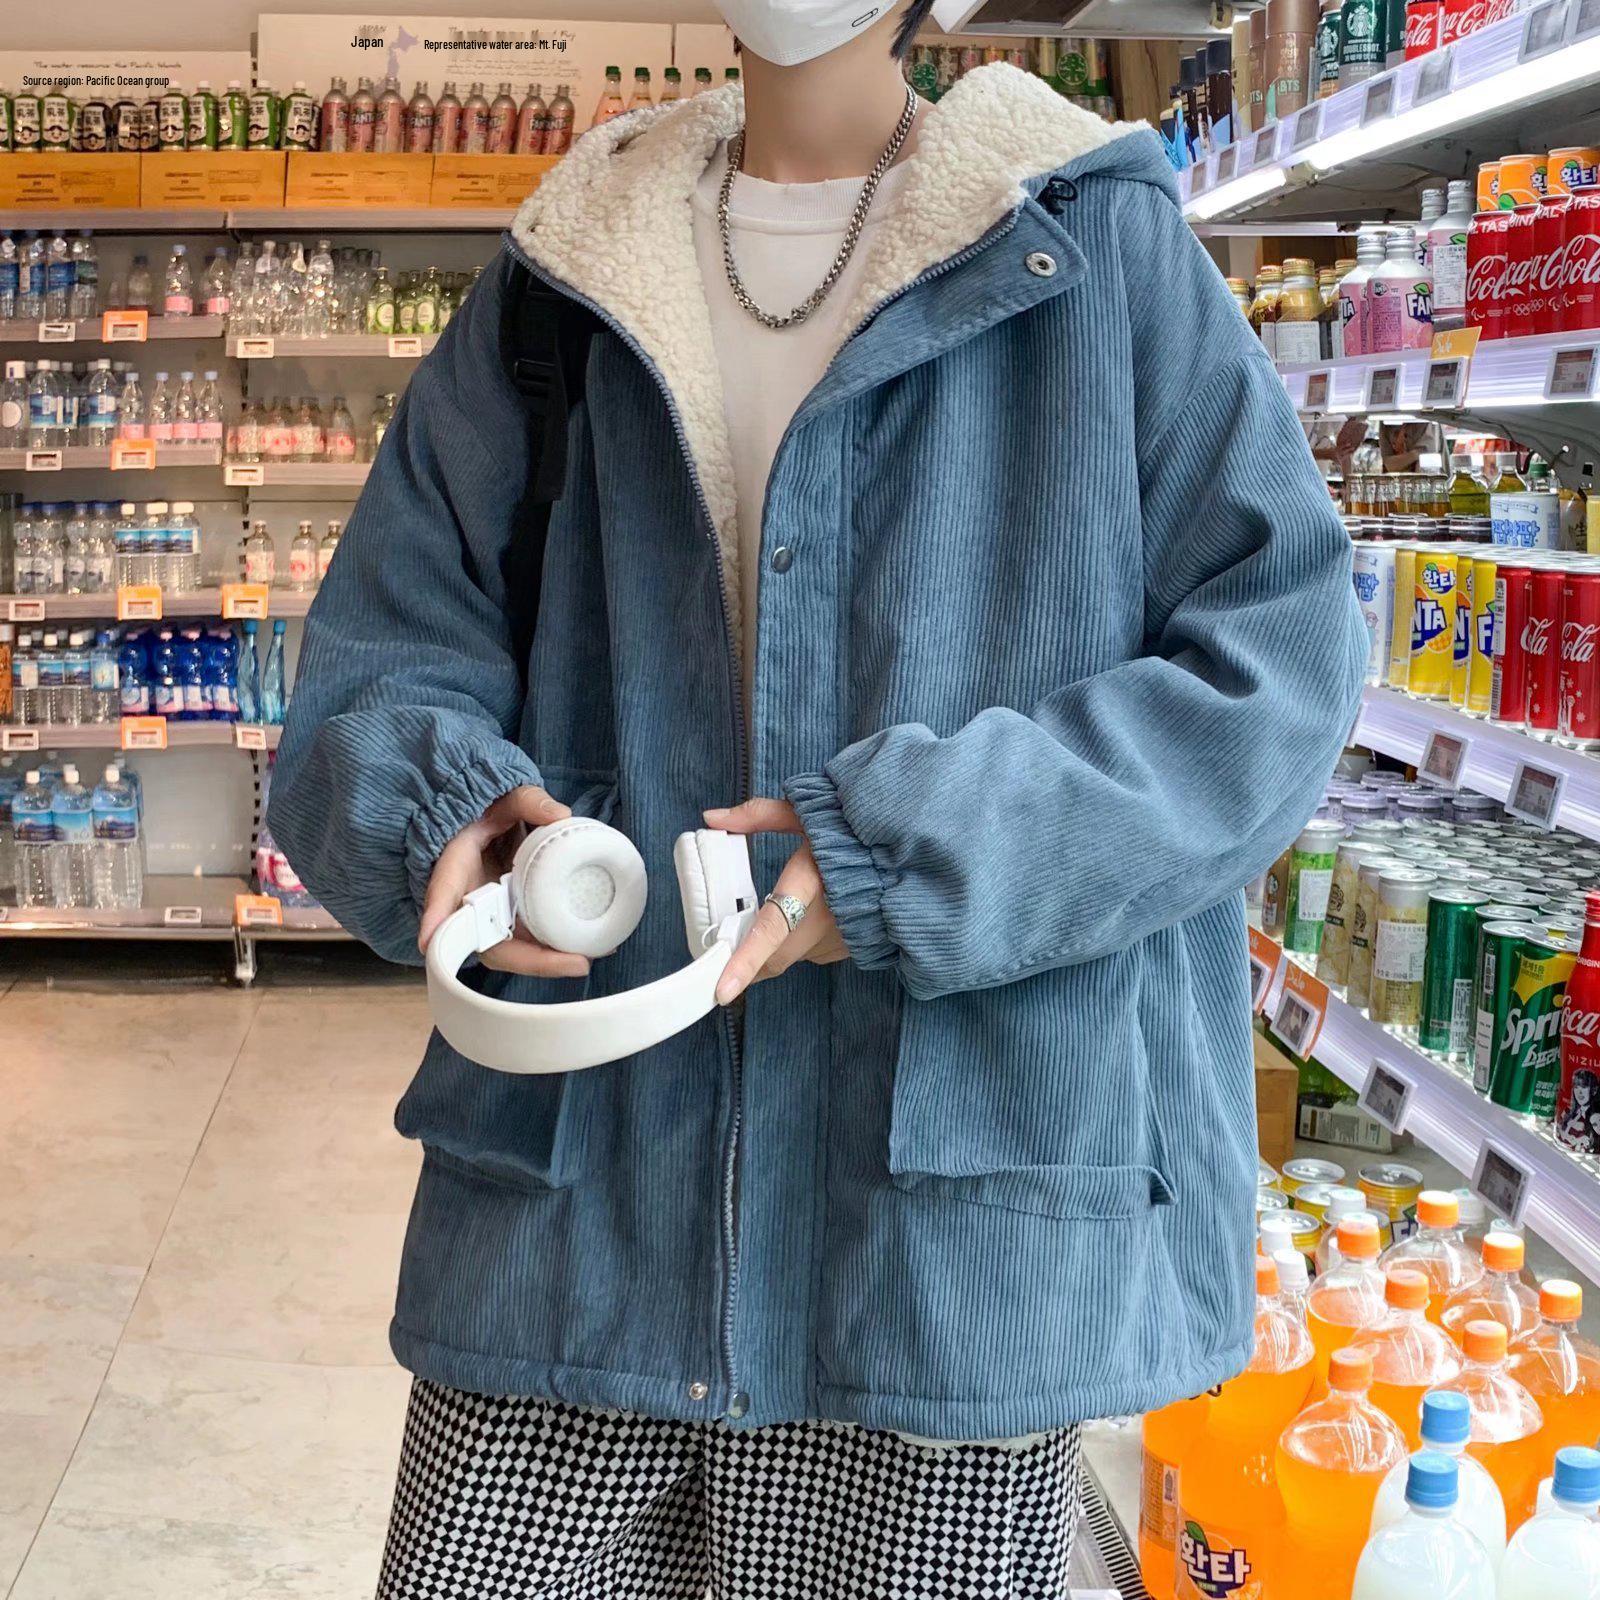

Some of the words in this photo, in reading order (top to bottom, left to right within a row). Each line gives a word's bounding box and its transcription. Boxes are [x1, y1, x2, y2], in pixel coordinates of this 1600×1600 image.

[1560, 165, 1598, 187] 환타
[1423, 569, 1456, 589] 환타
[1477, 613, 1494, 651] F
[1180, 1530, 1251, 1585] 환타
